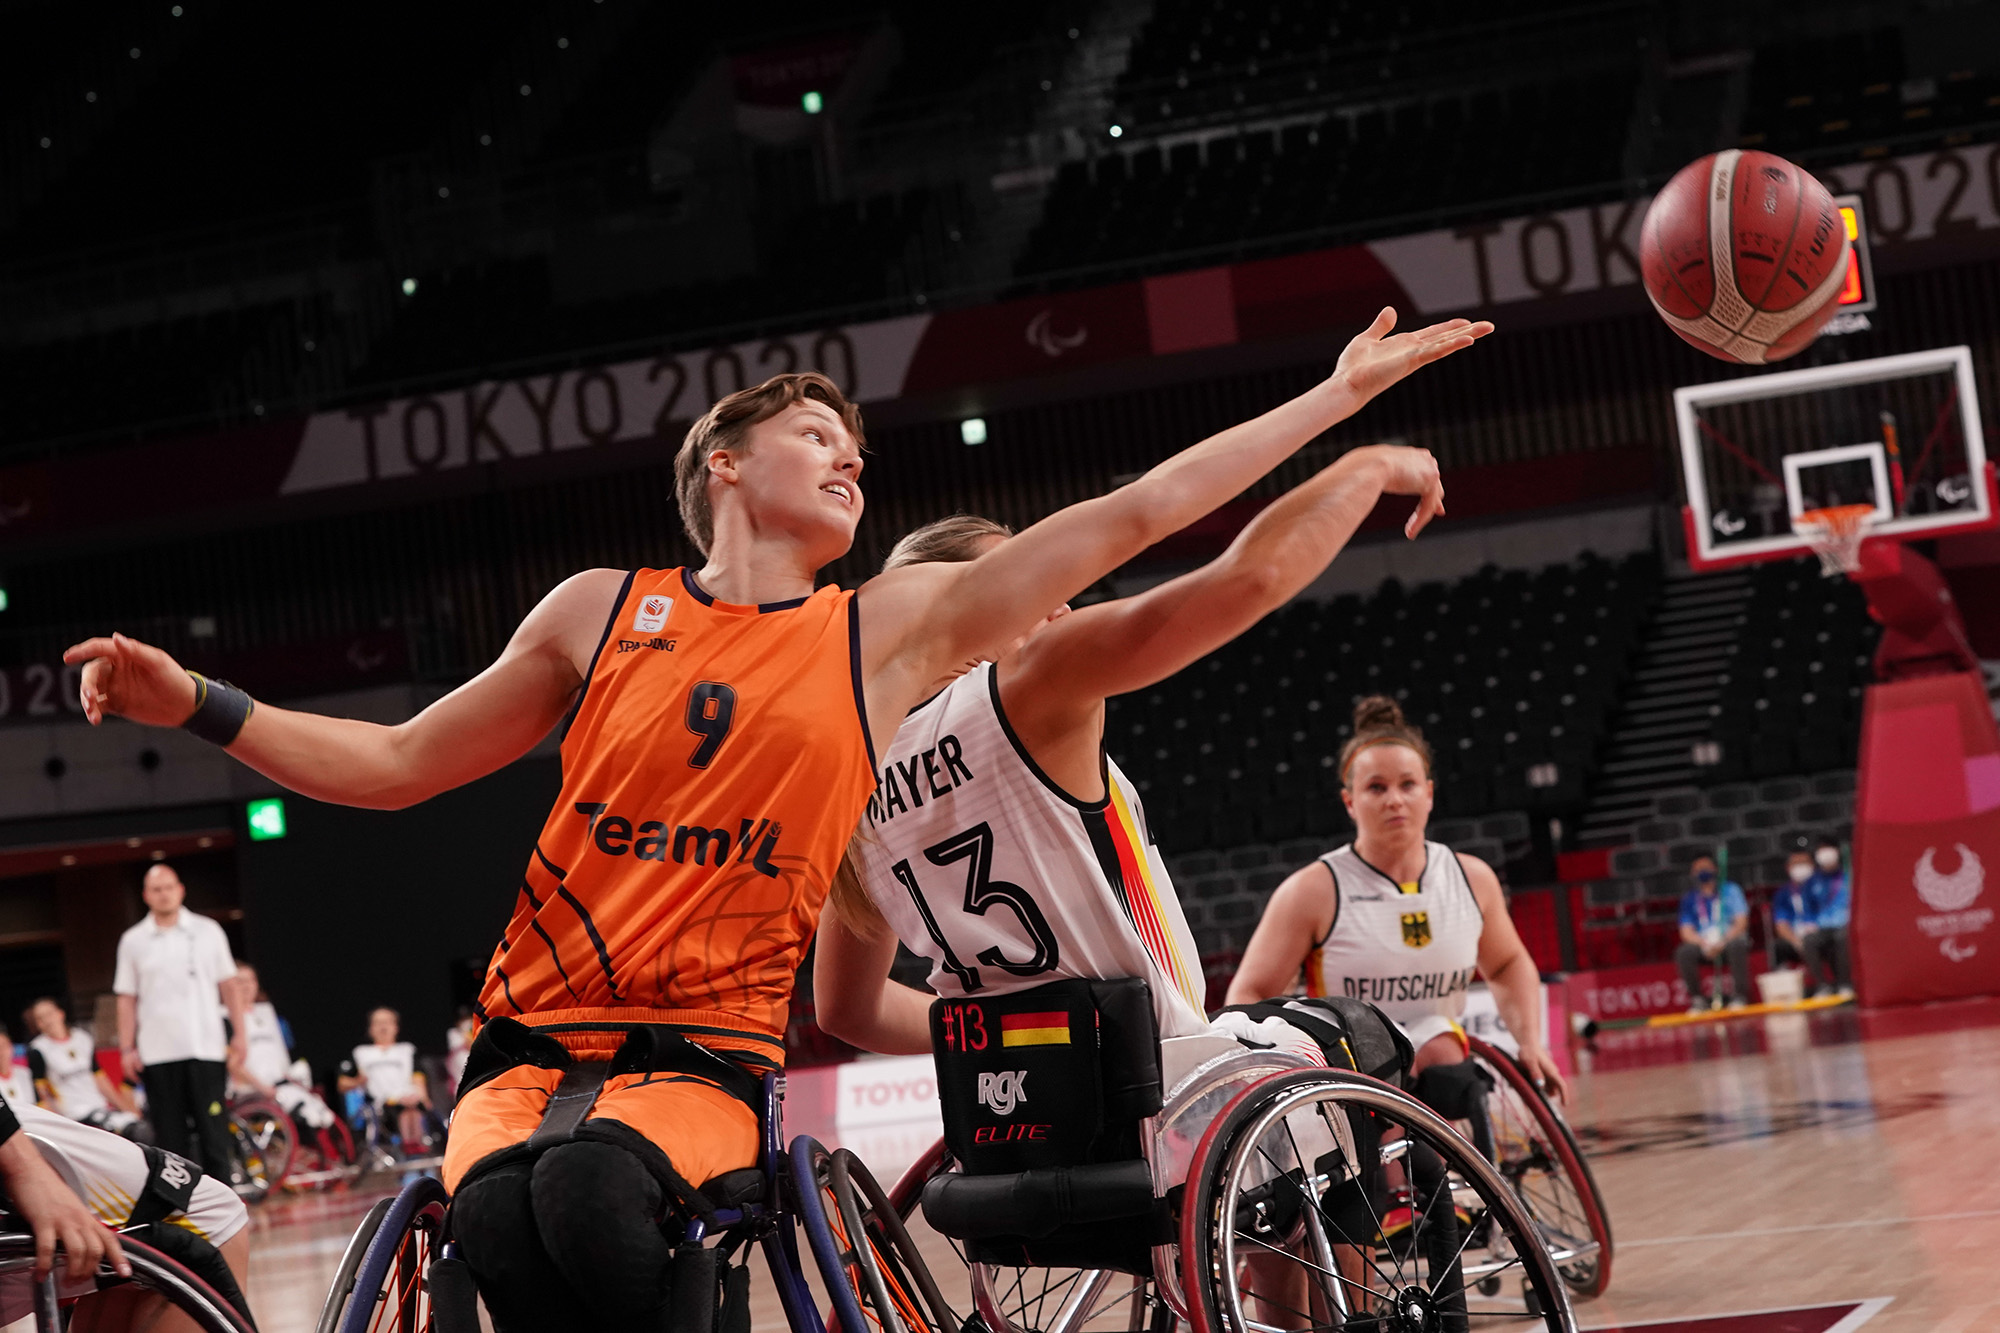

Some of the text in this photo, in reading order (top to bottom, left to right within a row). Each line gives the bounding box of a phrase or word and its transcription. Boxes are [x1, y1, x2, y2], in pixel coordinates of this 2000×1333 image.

[1456, 146, 2000, 306] TOK 02
[347, 364, 622, 482] TOKYO
[685, 680, 738, 770] 9
[891, 820, 1060, 994] 13
[1343, 964, 1478, 1002] DEUTSCHLAN
[942, 1003, 988, 1051] #13
[851, 1076, 937, 1108] TOYO
[974, 1124, 1052, 1144] ELITE
